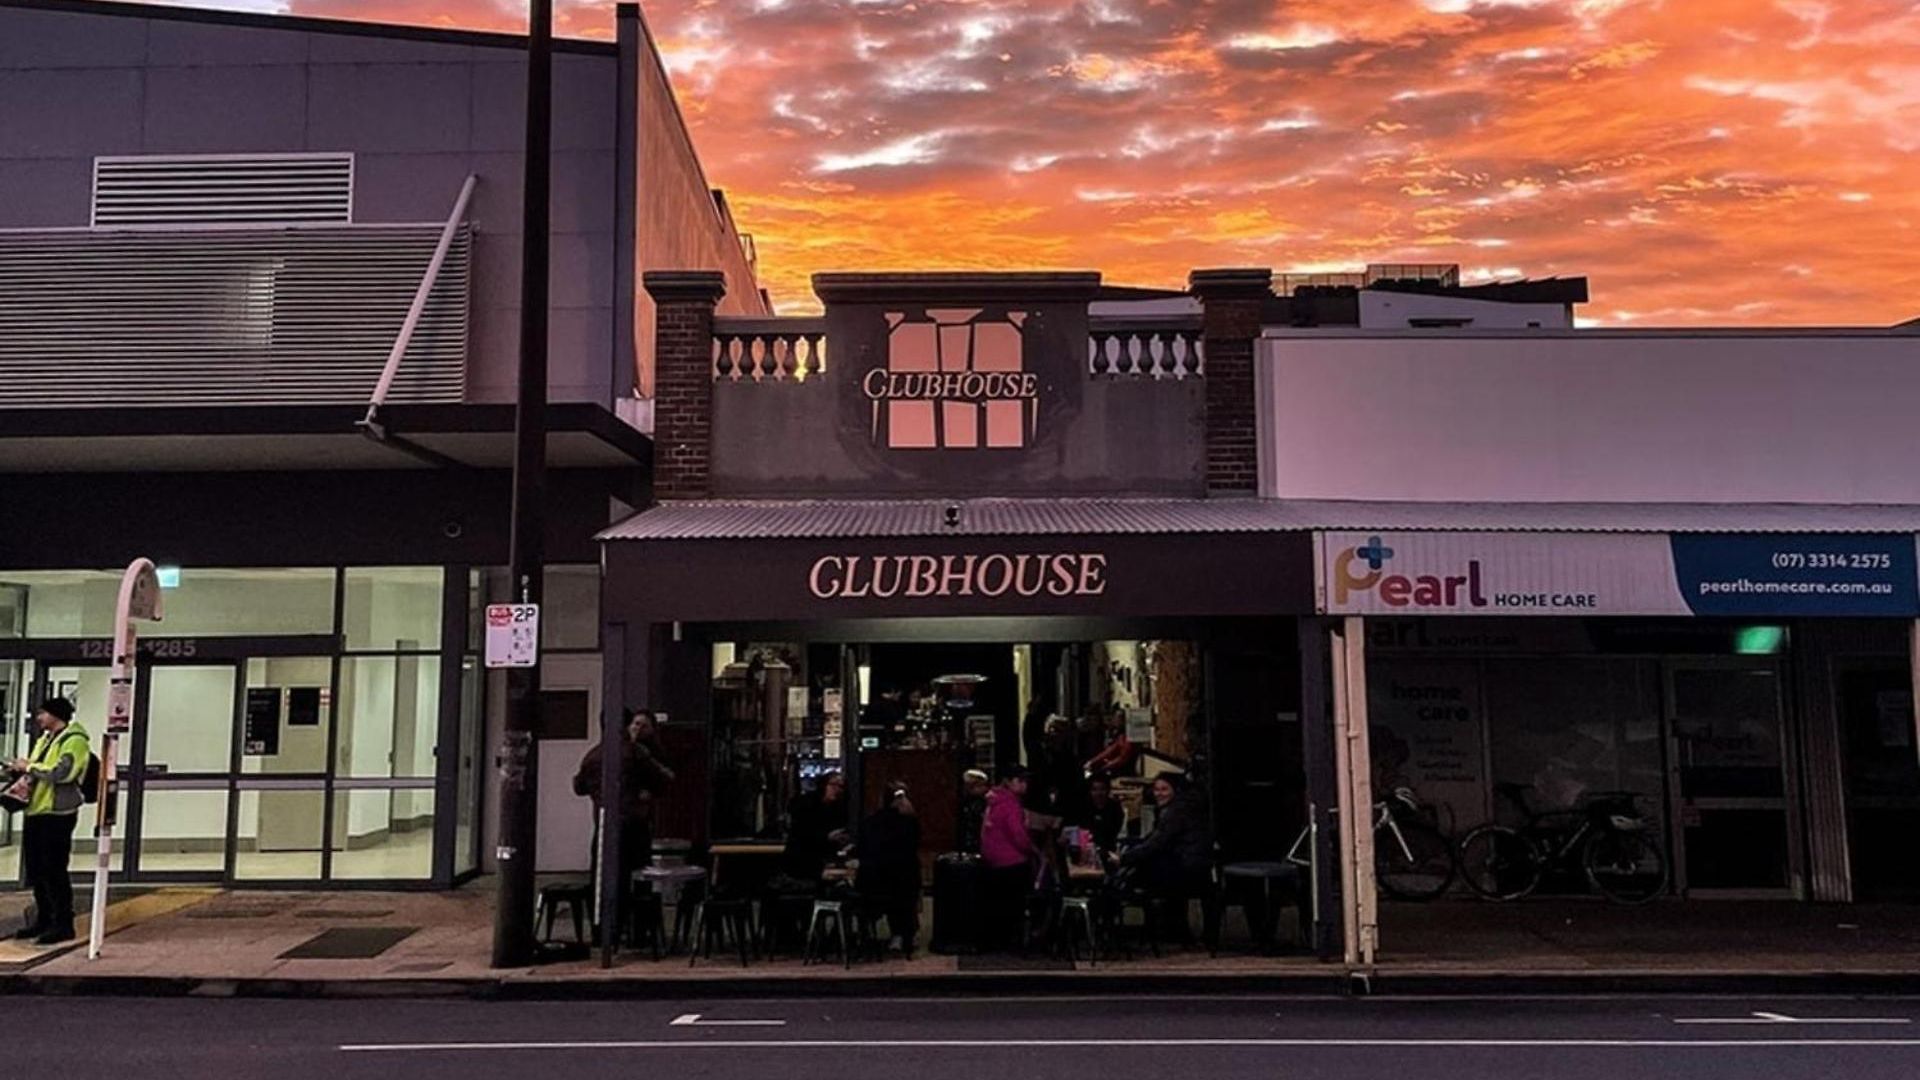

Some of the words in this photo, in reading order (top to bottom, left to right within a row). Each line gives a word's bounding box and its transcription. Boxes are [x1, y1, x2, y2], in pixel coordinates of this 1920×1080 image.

[863, 368, 1037, 398] CLUBHOUSE
[1771, 552, 1805, 569] (07)
[1808, 553, 1847, 568] 3314
[1851, 553, 1891, 568] 2575
[809, 553, 1107, 599] CLUBHOUSE
[1334, 537, 1487, 607] Pearl
[1700, 578, 1893, 595] pearlhomecare.com.au
[1494, 594, 1548, 607] HOME
[1551, 593, 1597, 607] CARE
[514, 607, 536, 622] 2P
[1391, 679, 1462, 700] home
